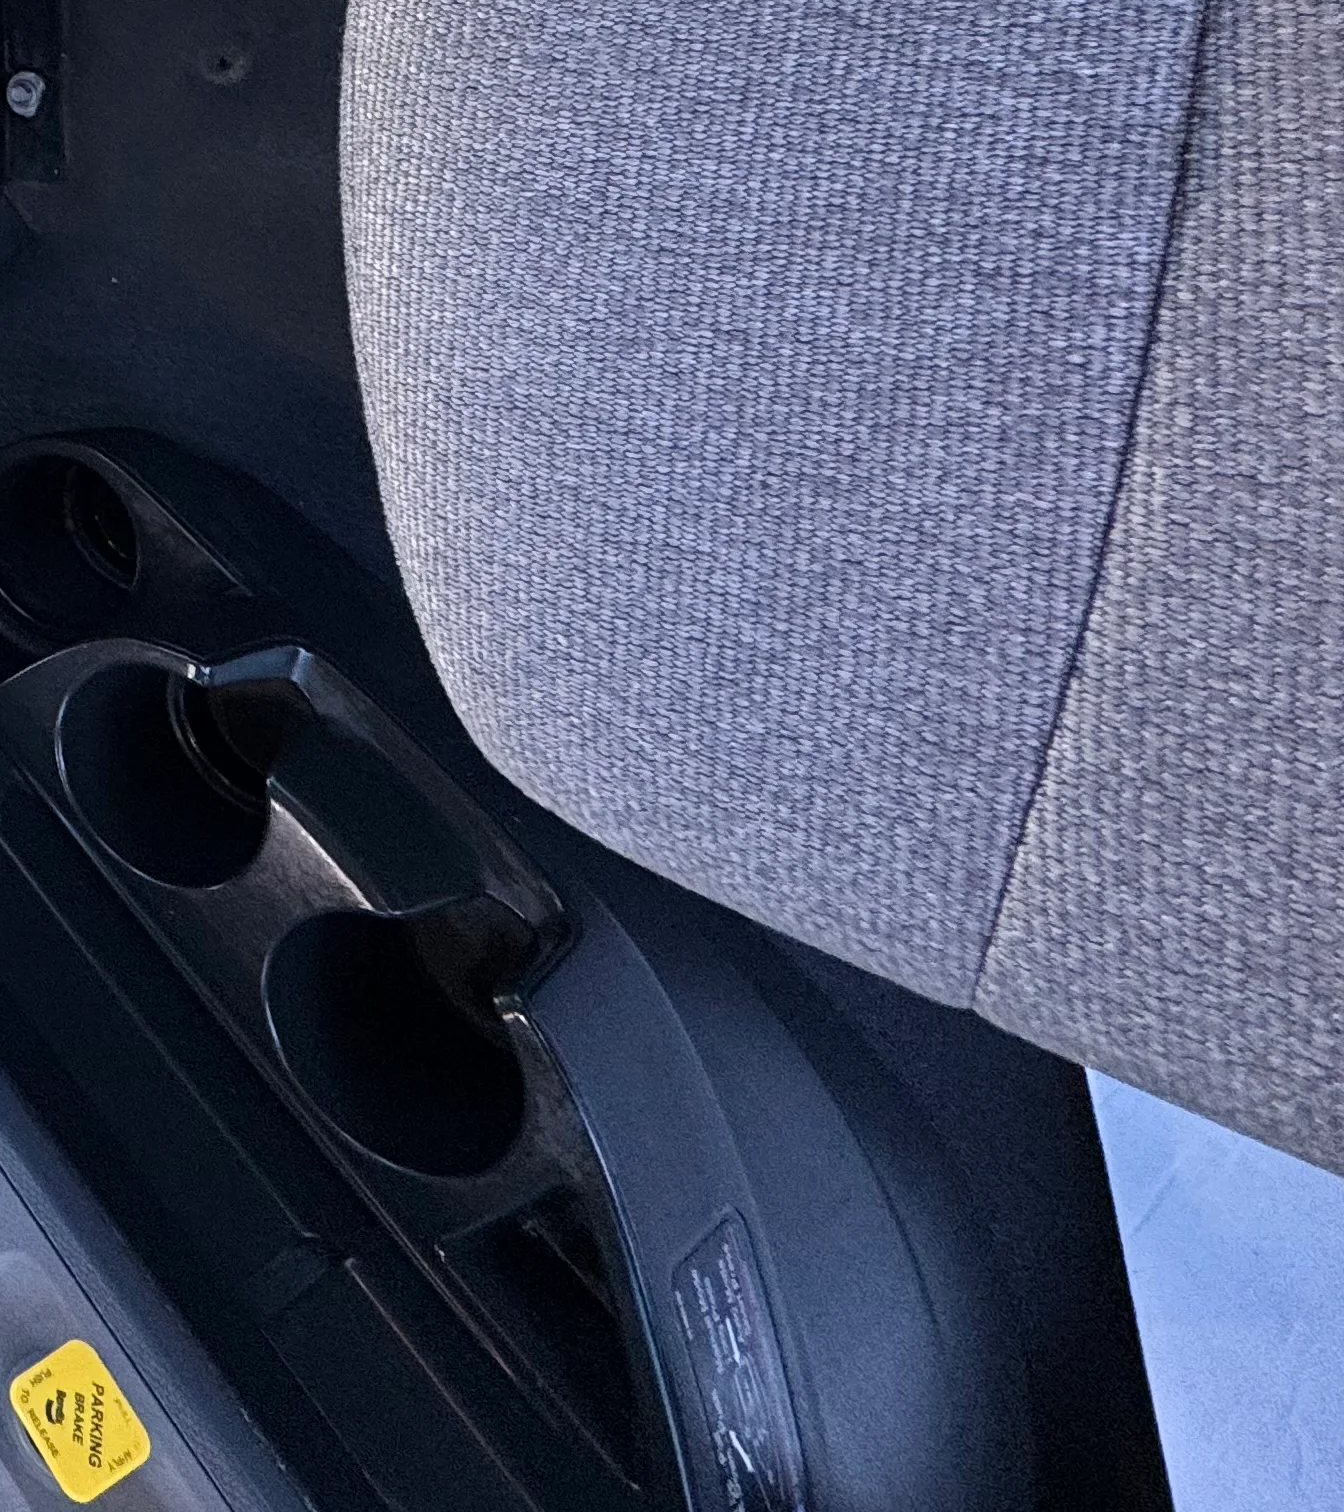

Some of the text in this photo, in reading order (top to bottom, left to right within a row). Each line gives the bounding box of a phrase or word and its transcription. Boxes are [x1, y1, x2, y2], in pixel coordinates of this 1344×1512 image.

[20, 1388, 31, 1404] TO
[28, 1407, 60, 1459] RELEASE
[72, 1391, 85, 1447] BRAKE
[88, 1381, 105, 1469] PARKING
